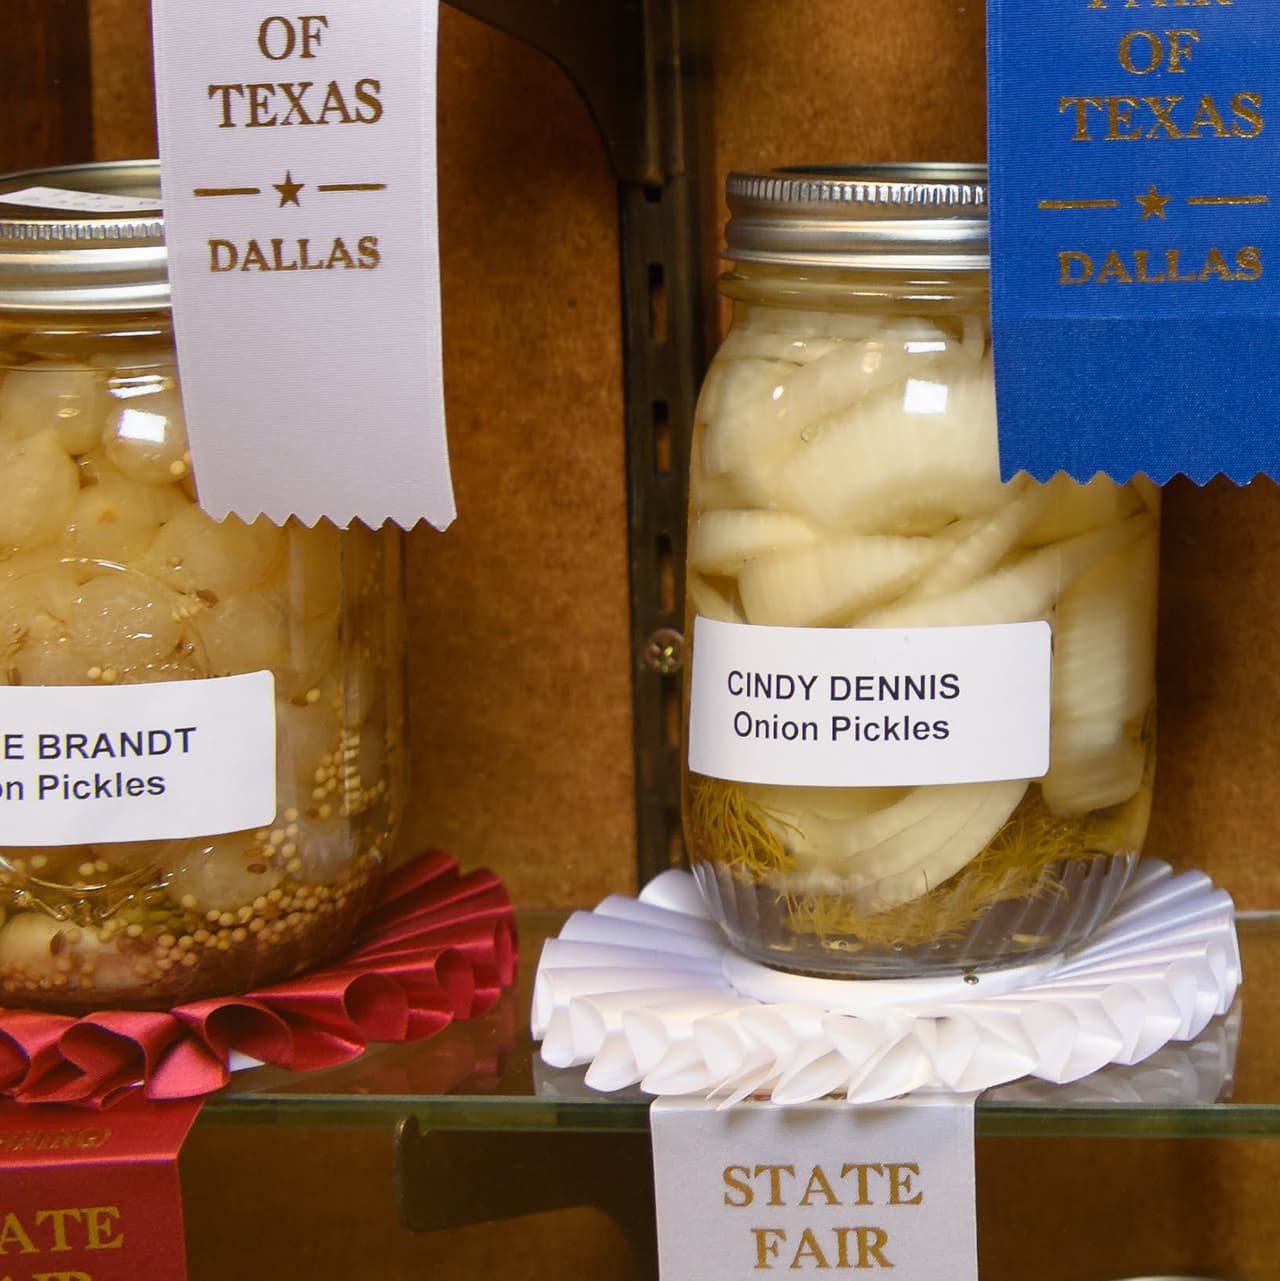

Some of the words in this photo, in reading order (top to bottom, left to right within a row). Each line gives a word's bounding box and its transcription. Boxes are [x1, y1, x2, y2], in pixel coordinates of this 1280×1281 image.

[257, 14, 328, 60] OF
[1118, 29, 1200, 75] OF
[207, 78, 384, 128] TEXAS
[1058, 92, 1265, 141] TEXAS
[207, 236, 381, 272] DALLAS
[1056, 246, 1263, 284] DALLAS
[727, 670, 818, 701] CINDY
[830, 673, 961, 702] DENNIS
[38, 726, 197, 760] BRANDT
[733, 710, 818, 741] Onion
[831, 714, 950, 742] Pickles
[38, 772, 166, 800] Pickles
[722, 1162, 923, 1208] STATE
[750, 1226, 895, 1269] FAIR
